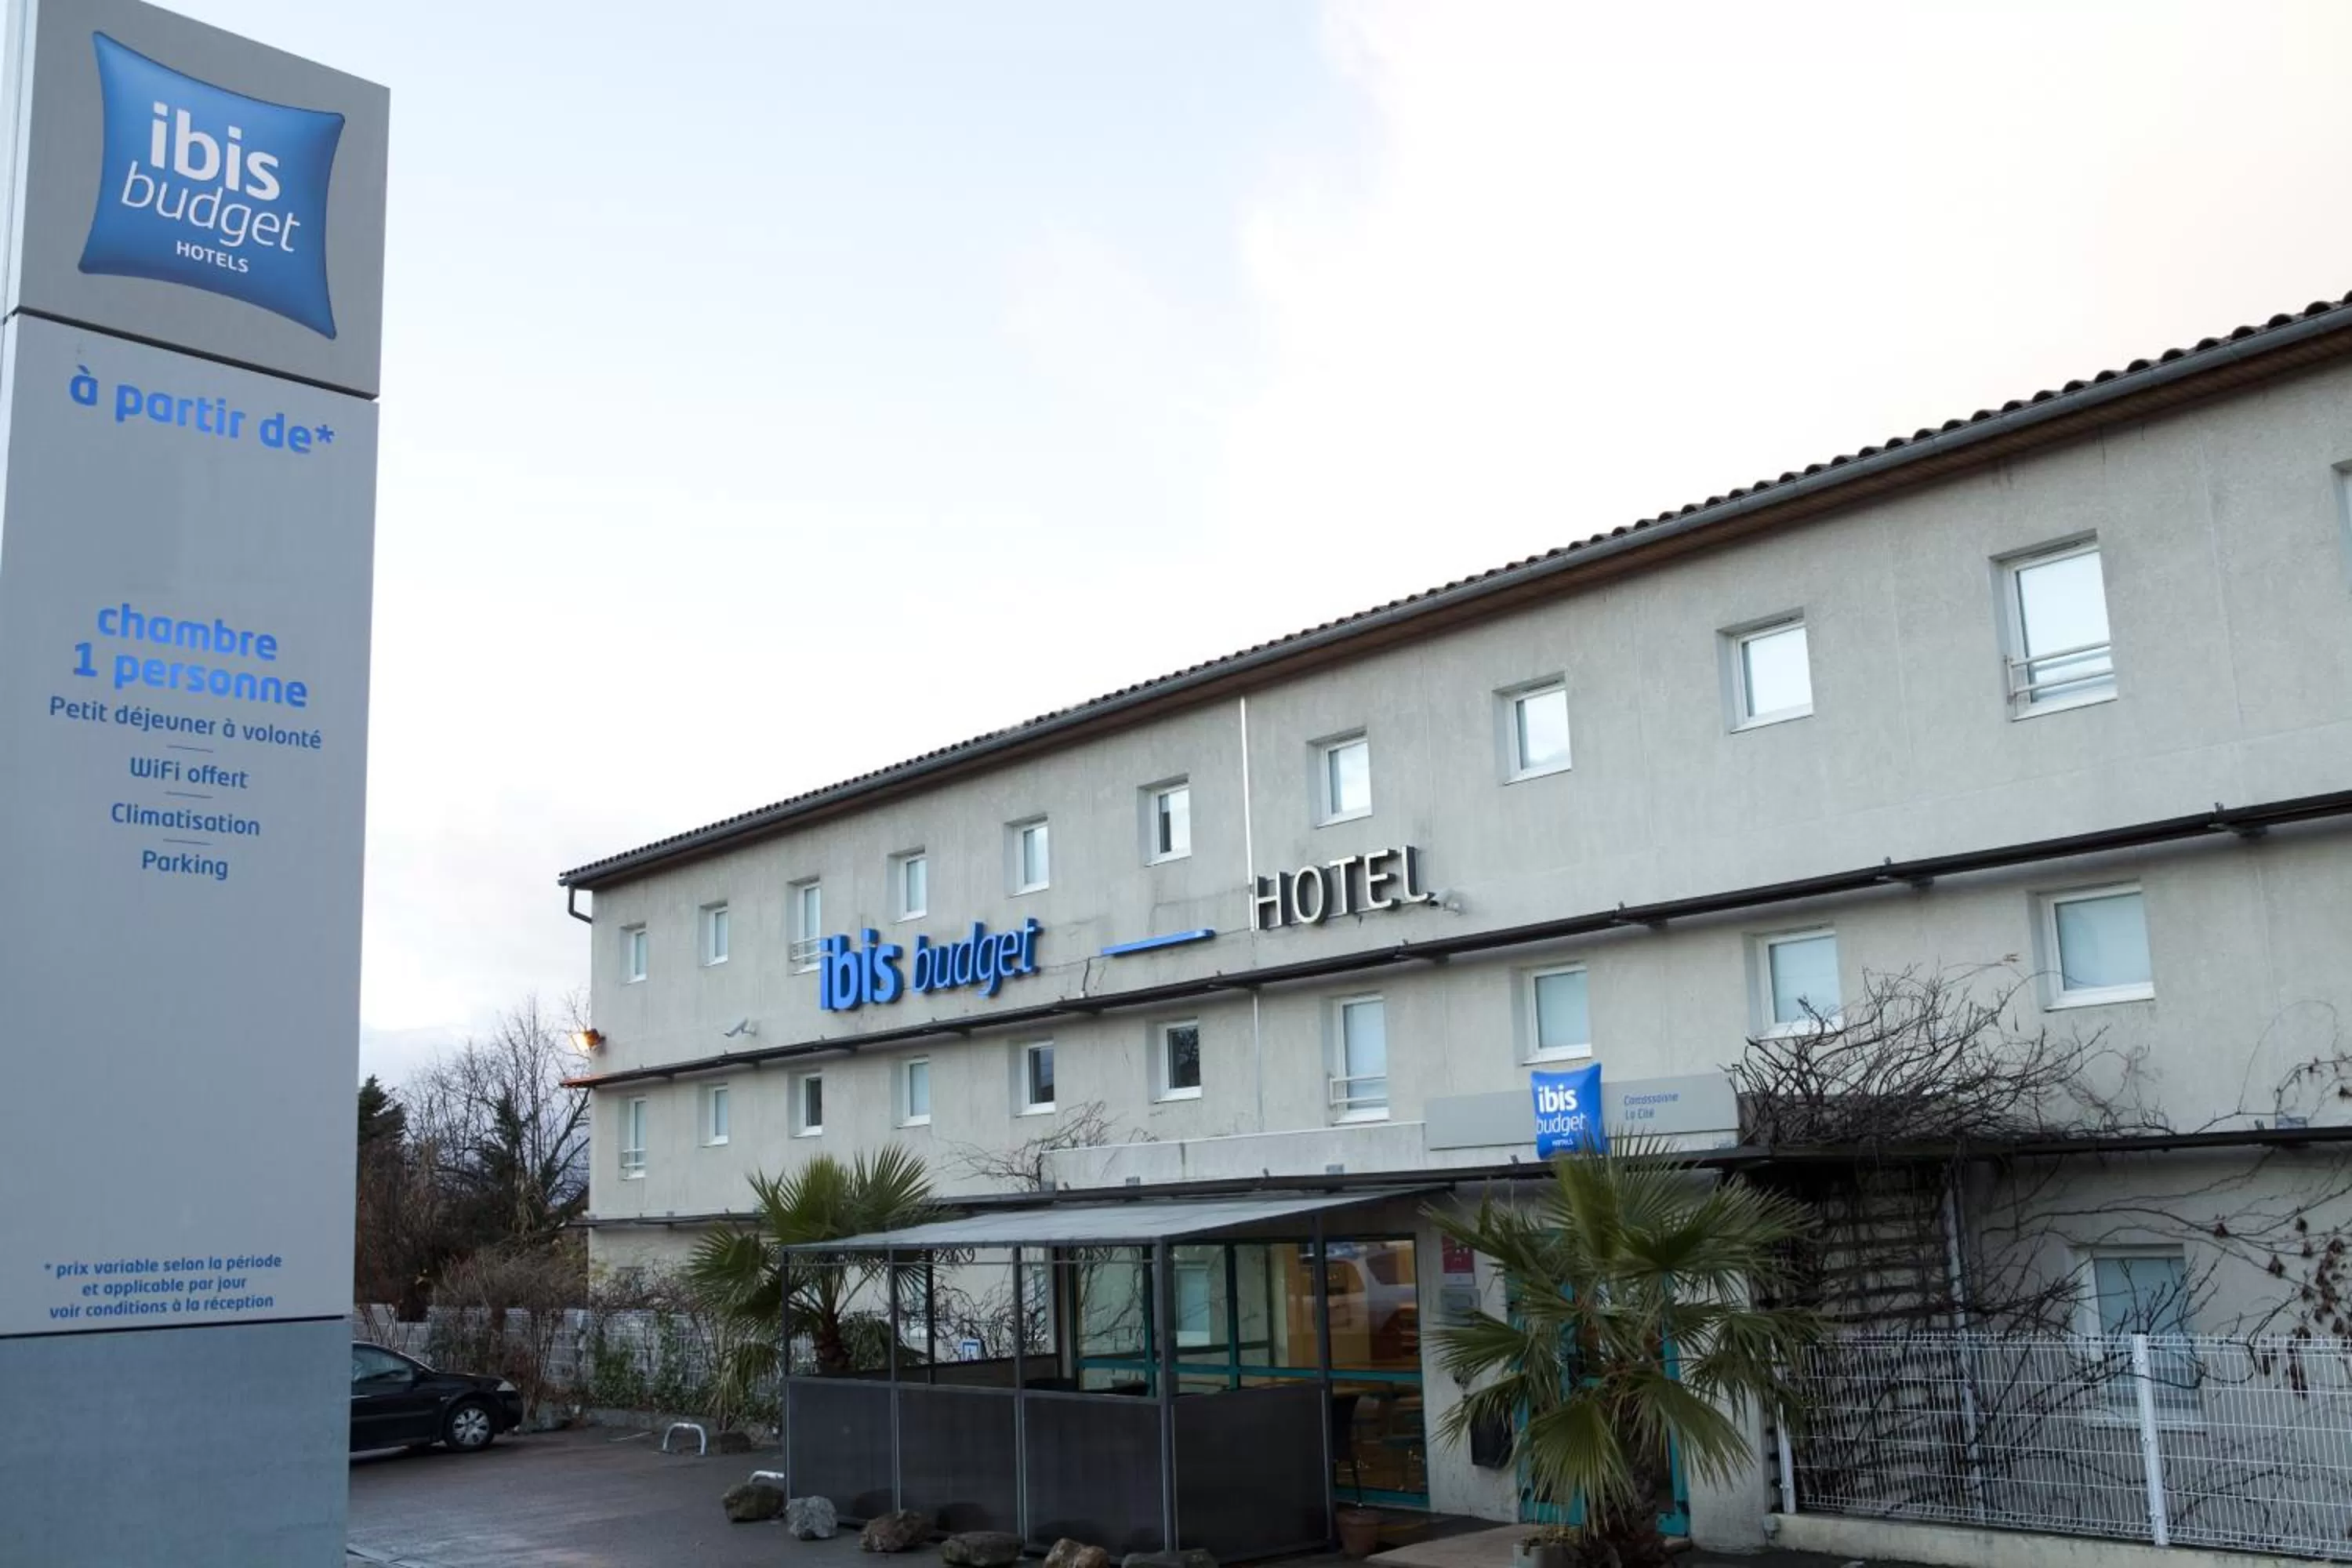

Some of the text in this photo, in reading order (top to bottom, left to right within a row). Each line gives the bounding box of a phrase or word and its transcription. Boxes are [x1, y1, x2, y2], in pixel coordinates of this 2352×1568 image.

[150, 101, 281, 201] ibis
[121, 160, 301, 252] budget
[176, 241, 249, 273] HOTELS
[70, 365, 98, 406] à
[116, 383, 245, 439] partir
[98, 603, 278, 661] chambre
[73, 642, 308, 707] 1 personne
[49, 695, 322, 750] Petit déjeuner à volonté
[130, 757, 249, 789] WiFi offert
[111, 803, 261, 837] Climatisation
[142, 851, 229, 881] Parking
[1255, 844, 1435, 931] HOTEL
[820, 916, 1041, 1011] ibis budget
[1537, 1083, 1578, 1112] ibis
[1536, 1112, 1586, 1137] budget
[56, 1261, 89, 1279] prix
[93, 1258, 159, 1275] variable
[163, 1257, 205, 1272] selon
[209, 1255, 223, 1270] la
[227, 1254, 283, 1272] période
[82, 1276, 247, 1298] et applicable par jour
[49, 1294, 274, 1319] voir conditions à la réception
